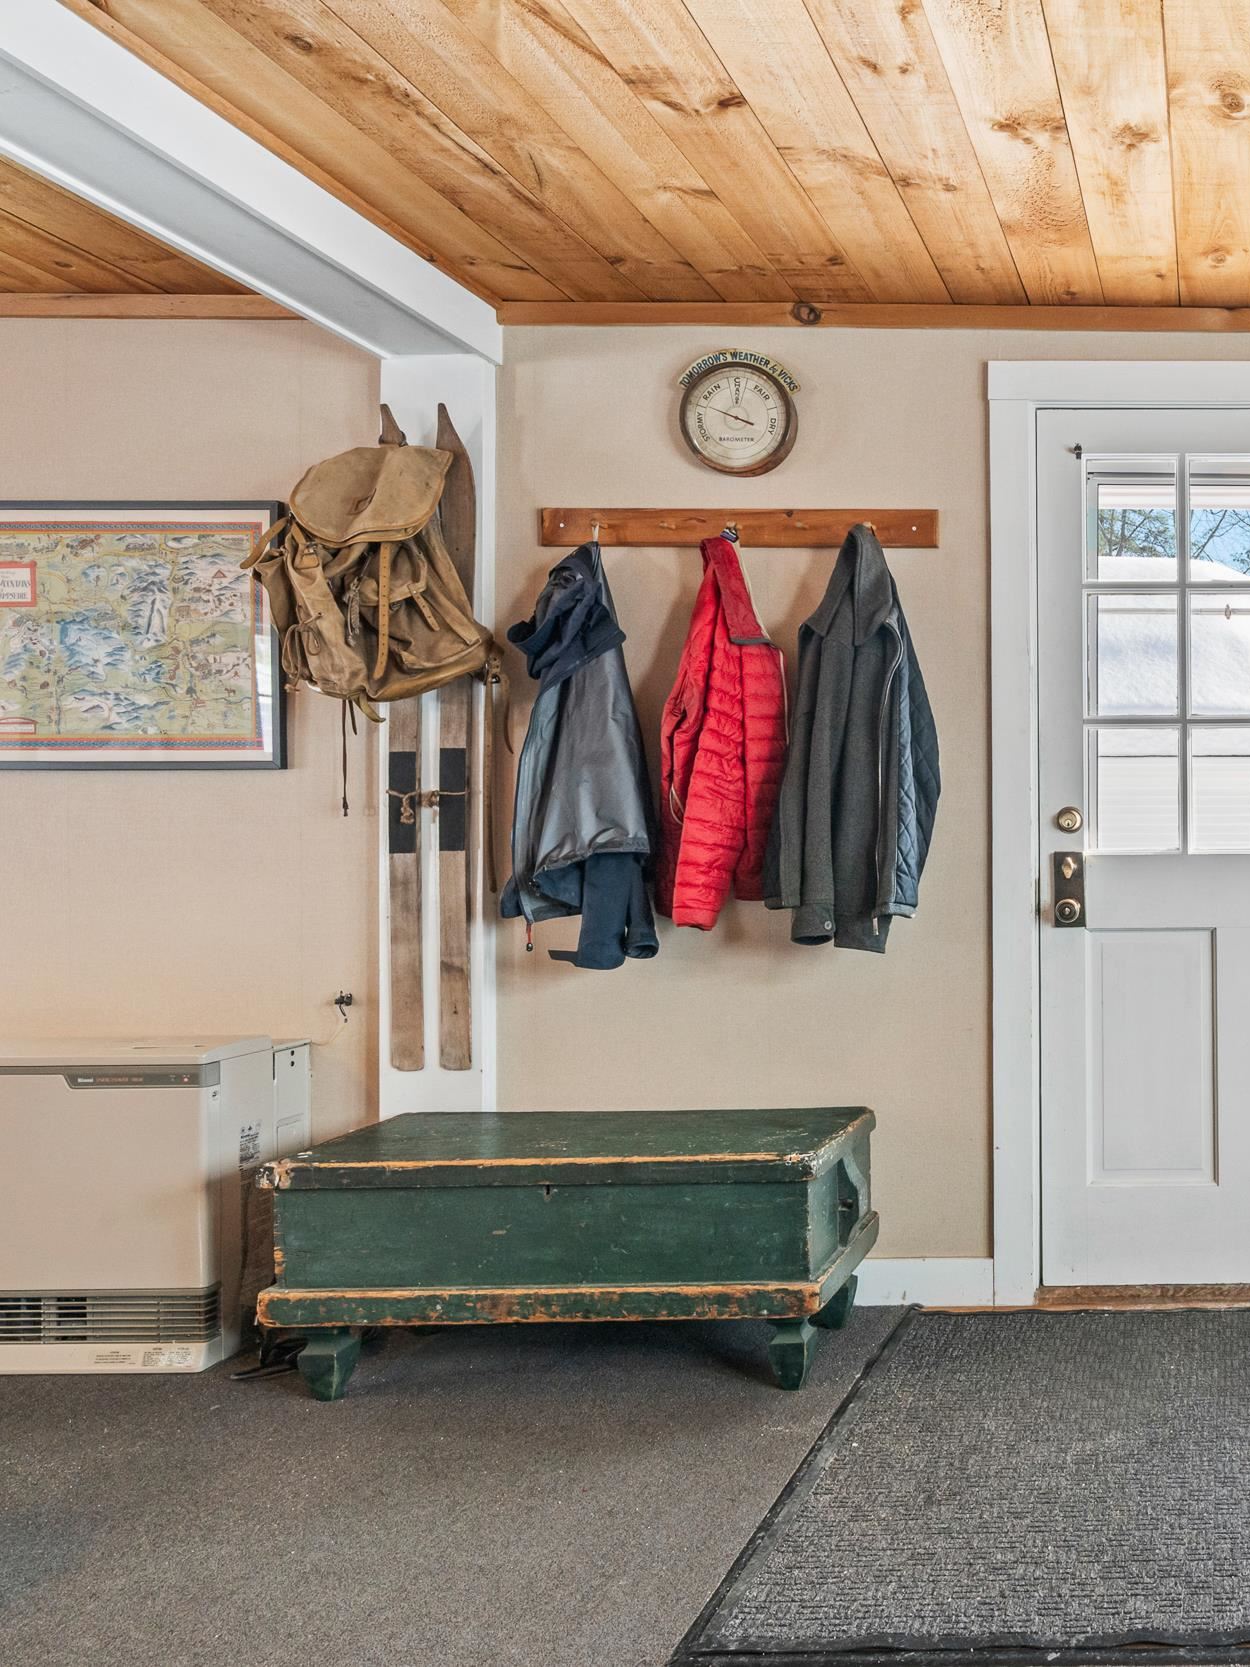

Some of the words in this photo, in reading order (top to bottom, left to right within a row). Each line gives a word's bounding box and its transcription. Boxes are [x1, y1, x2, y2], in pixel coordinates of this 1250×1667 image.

[679, 352, 728, 389] TOMORROW'S
[730, 351, 771, 369] WEATHER
[769, 364, 779, 375] by
[778, 369, 799, 392] VICKS
[703, 383, 721, 401] RAIN
[753, 384, 771, 401] FAIR
[696, 411, 711, 442] STORMY
[768, 417, 777, 436] DRY
